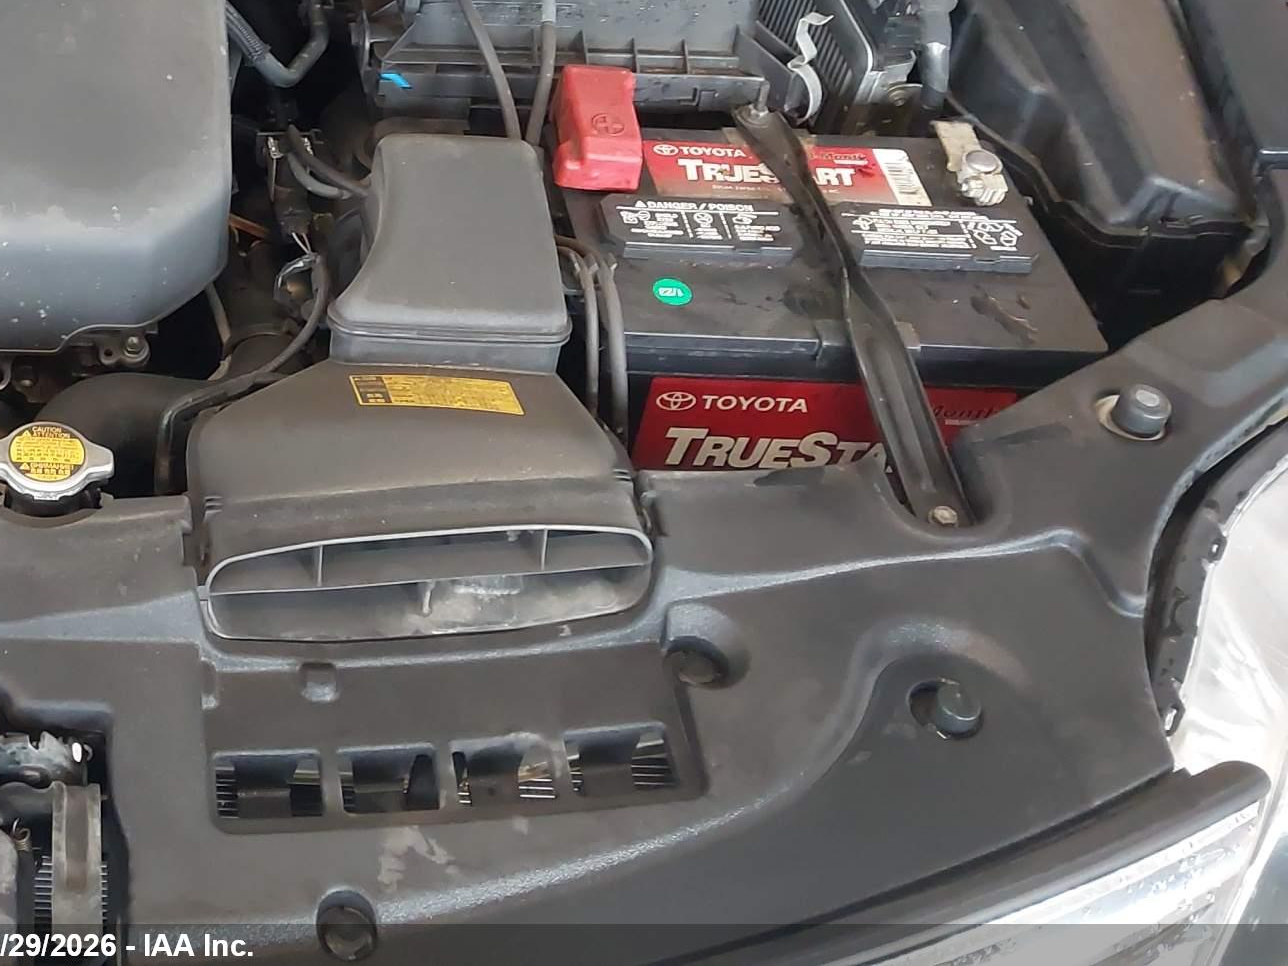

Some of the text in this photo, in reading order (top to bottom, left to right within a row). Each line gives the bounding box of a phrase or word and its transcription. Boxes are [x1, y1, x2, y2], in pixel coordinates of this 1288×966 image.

[679, 146, 746, 158] TOYOTA
[647, 201, 697, 210] DANGER
[708, 204, 754, 212] POISON
[701, 395, 808, 414] TOYOTA
